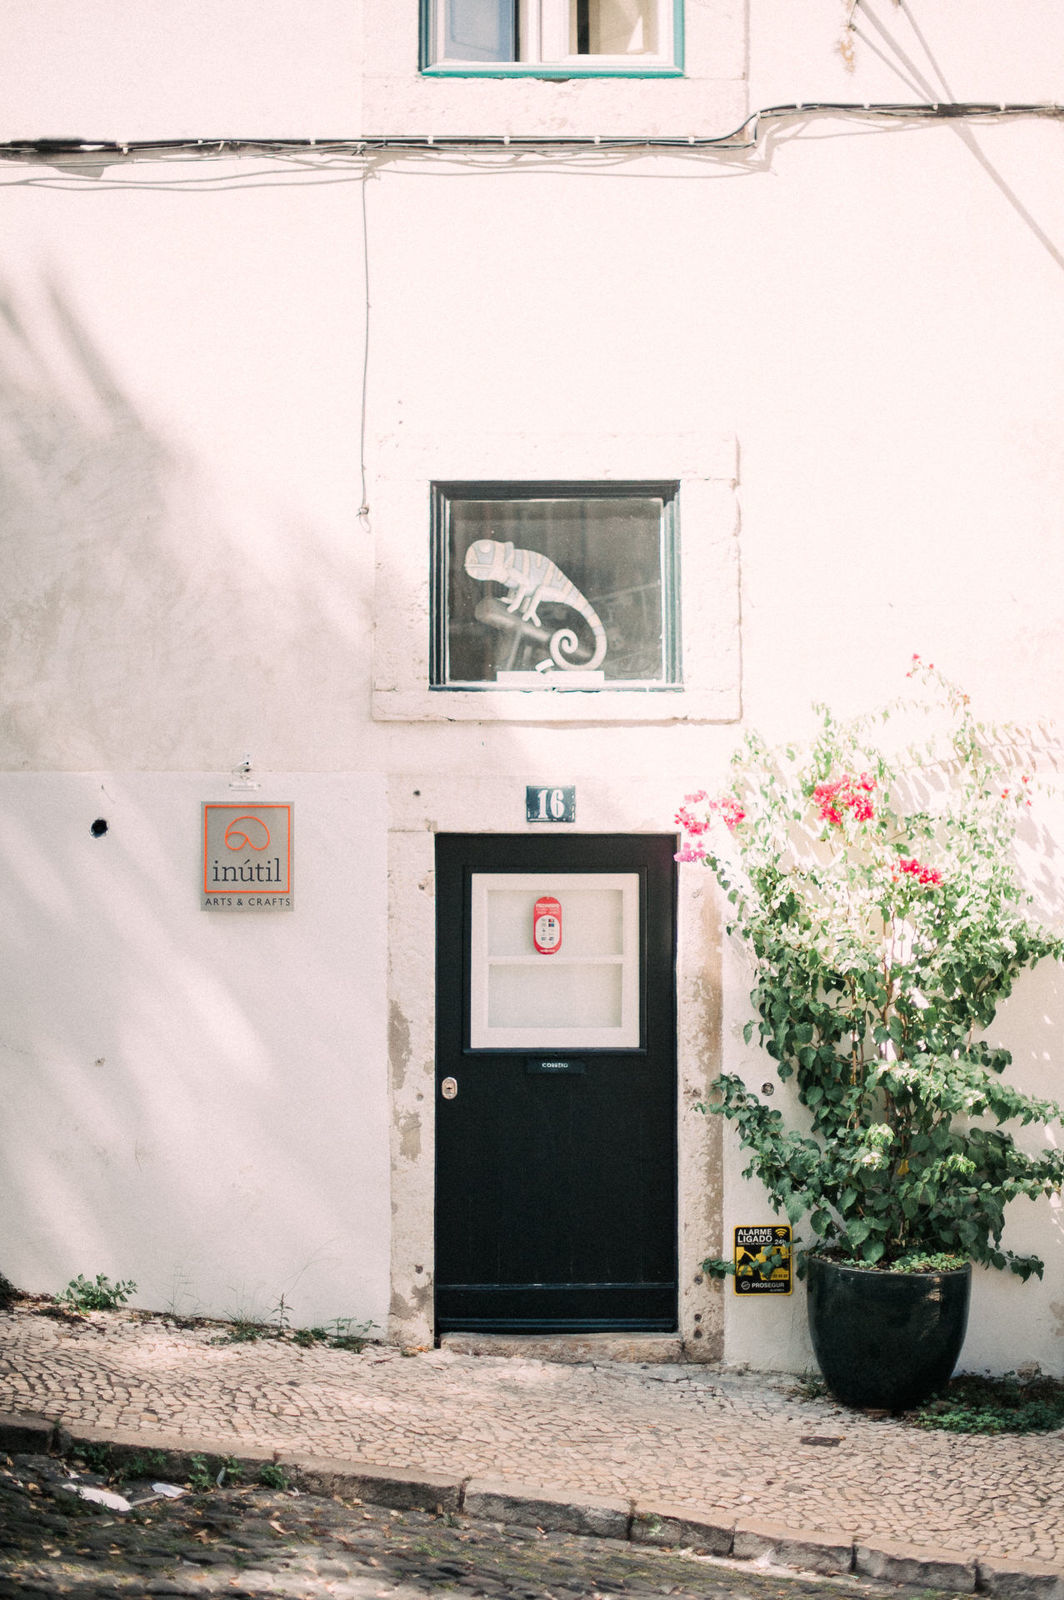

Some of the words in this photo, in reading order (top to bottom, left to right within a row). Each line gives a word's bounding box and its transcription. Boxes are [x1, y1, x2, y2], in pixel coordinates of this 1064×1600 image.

[537, 789, 565, 819] 16
[212, 857, 282, 883] inútil
[205, 898, 232, 906] ARTS
[236, 898, 243, 906] &
[248, 898, 291, 906] CRAFTS
[737, 1228, 773, 1236] ALARME
[737, 1235, 773, 1243] LIGADO
